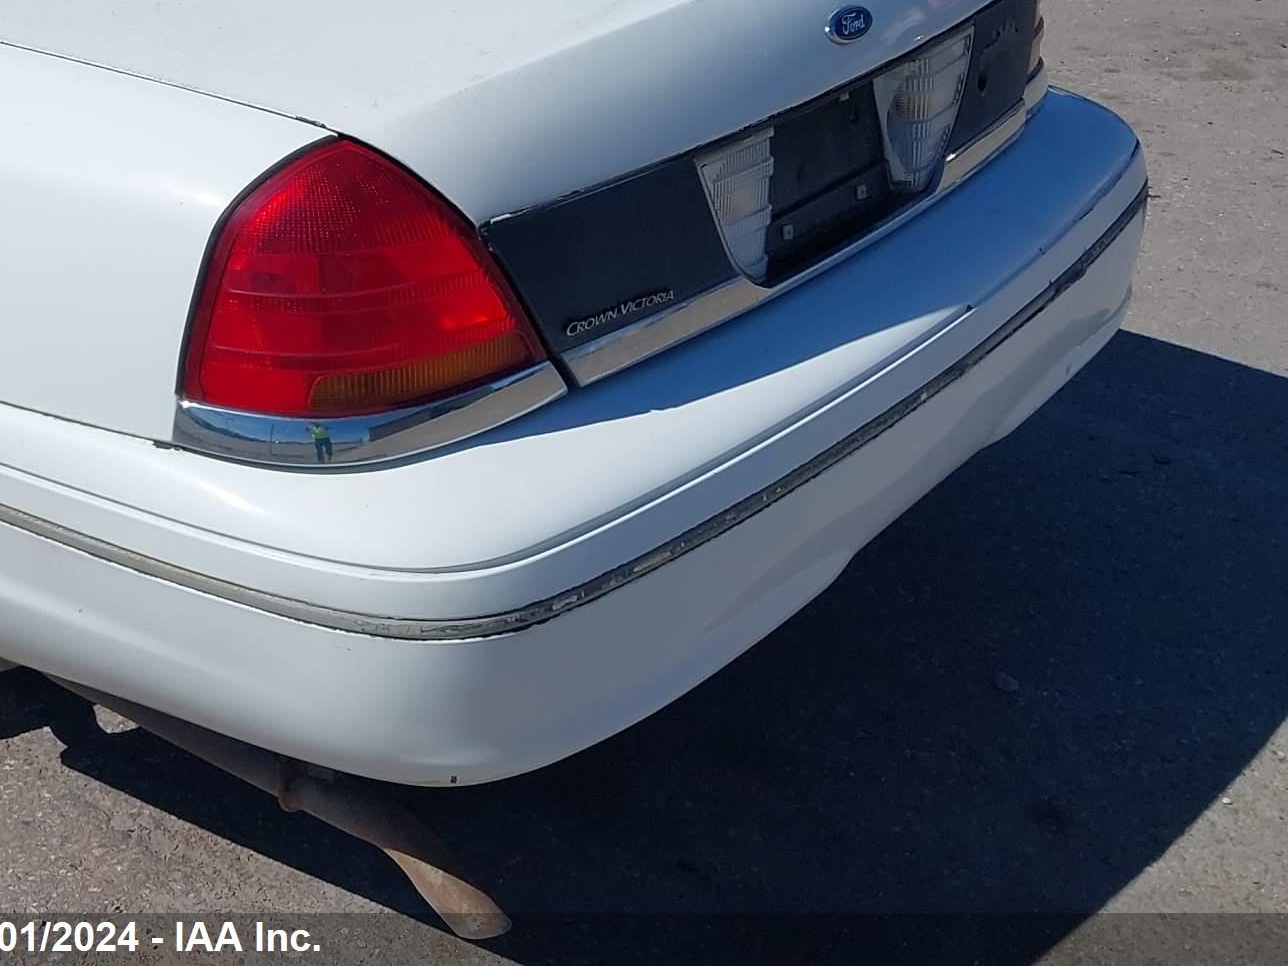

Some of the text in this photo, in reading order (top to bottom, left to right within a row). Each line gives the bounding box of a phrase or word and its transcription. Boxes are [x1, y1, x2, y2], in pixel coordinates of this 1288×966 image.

[841, 12, 866, 35] Ford
[566, 289, 674, 336] CROWN VICTORIA
